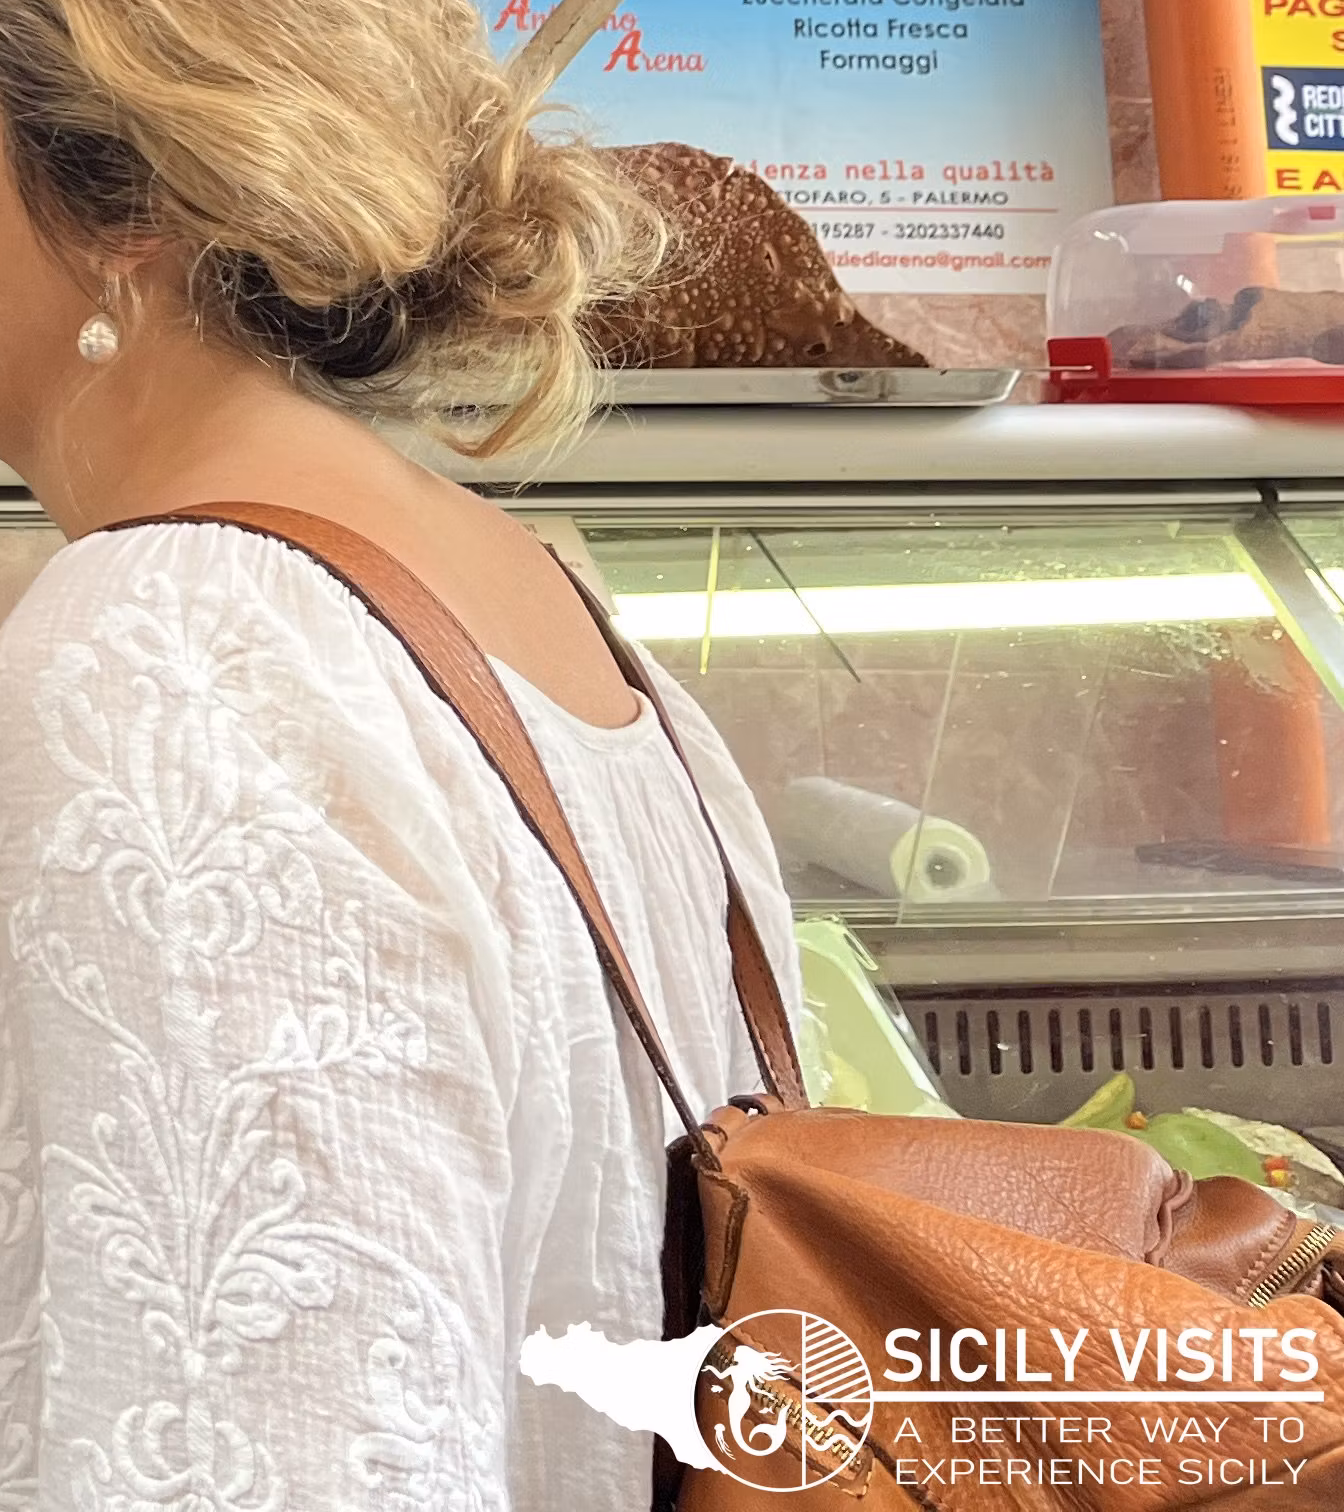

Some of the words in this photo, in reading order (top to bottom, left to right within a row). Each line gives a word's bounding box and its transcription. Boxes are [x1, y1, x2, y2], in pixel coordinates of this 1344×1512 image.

[794, 19, 878, 38] Ricotta
[888, 19, 968, 39] Fresca
[603, 29, 705, 72] Arena
[820, 50, 938, 74] Formaggi
[846, 159, 925, 180] nella
[943, 159, 1055, 183] qualità
[880, 191, 890, 204] 5
[913, 190, 1009, 205] PALERMO
[895, 222, 1005, 238] 3202337440
